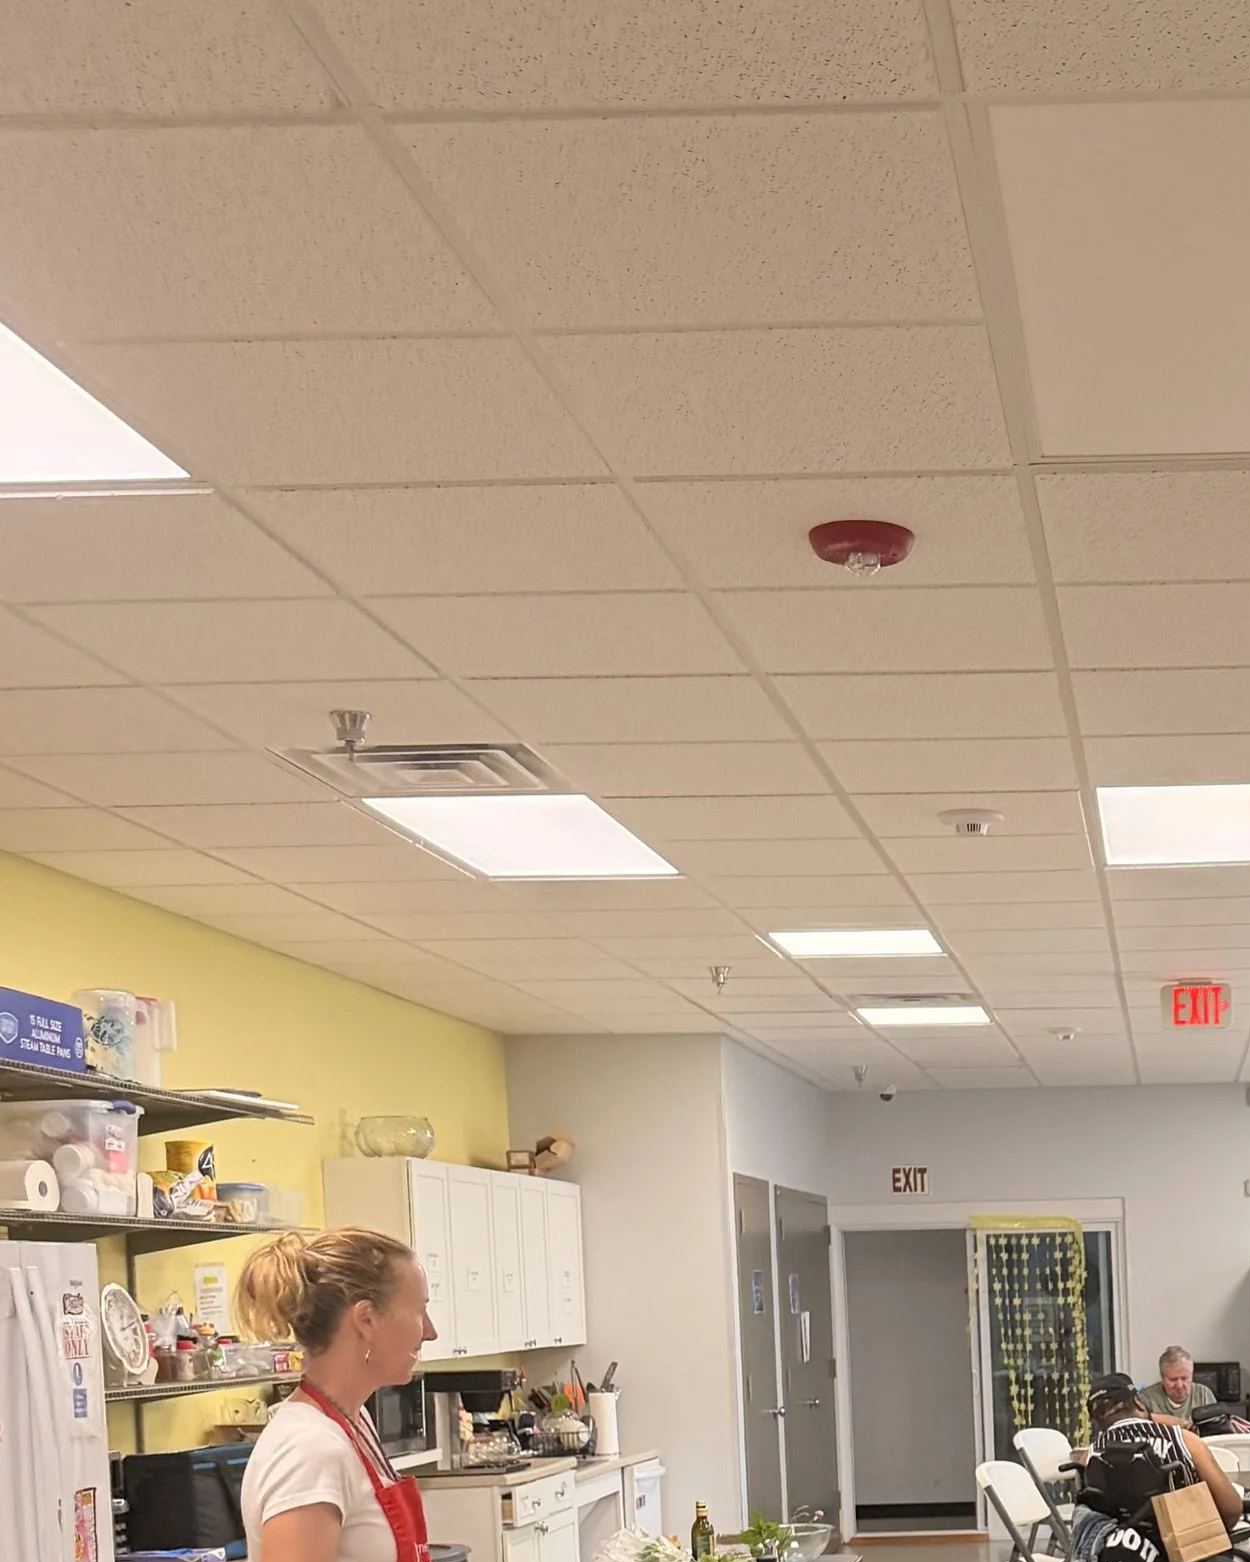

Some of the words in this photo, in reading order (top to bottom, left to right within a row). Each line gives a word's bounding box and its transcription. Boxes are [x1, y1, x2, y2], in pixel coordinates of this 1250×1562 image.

[1172, 985, 1223, 1027] EXIT
[29, 1014, 36, 1026] 15
[36, 1016, 49, 1029] FULL
[50, 1019, 62, 1032] SIZE
[20, 1038, 39, 1051] STEAM
[39, 1042, 56, 1055] TABLE
[56, 1046, 71, 1059] PANS
[892, 1167, 928, 1193] EXIT
